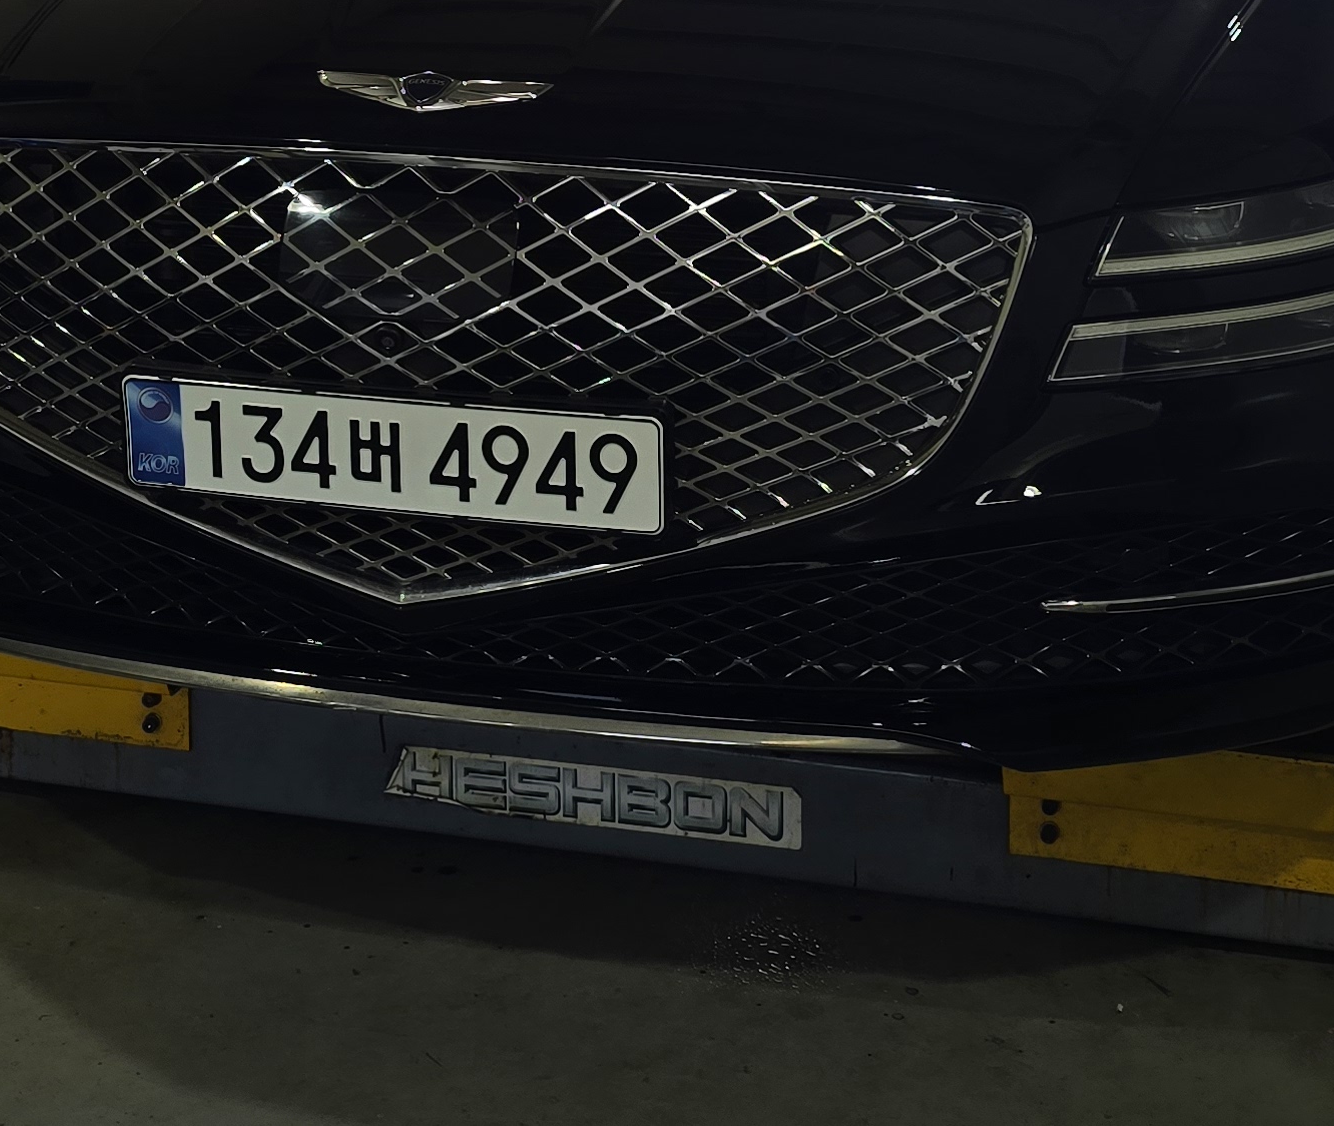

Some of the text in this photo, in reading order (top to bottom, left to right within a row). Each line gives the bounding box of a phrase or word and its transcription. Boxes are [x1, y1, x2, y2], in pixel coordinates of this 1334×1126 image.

[408, 78, 445, 86] GENESIS
[137, 452, 179, 475] KOR
[193, 400, 639, 515] 134버 4949
[402, 750, 785, 842] HESHBON
